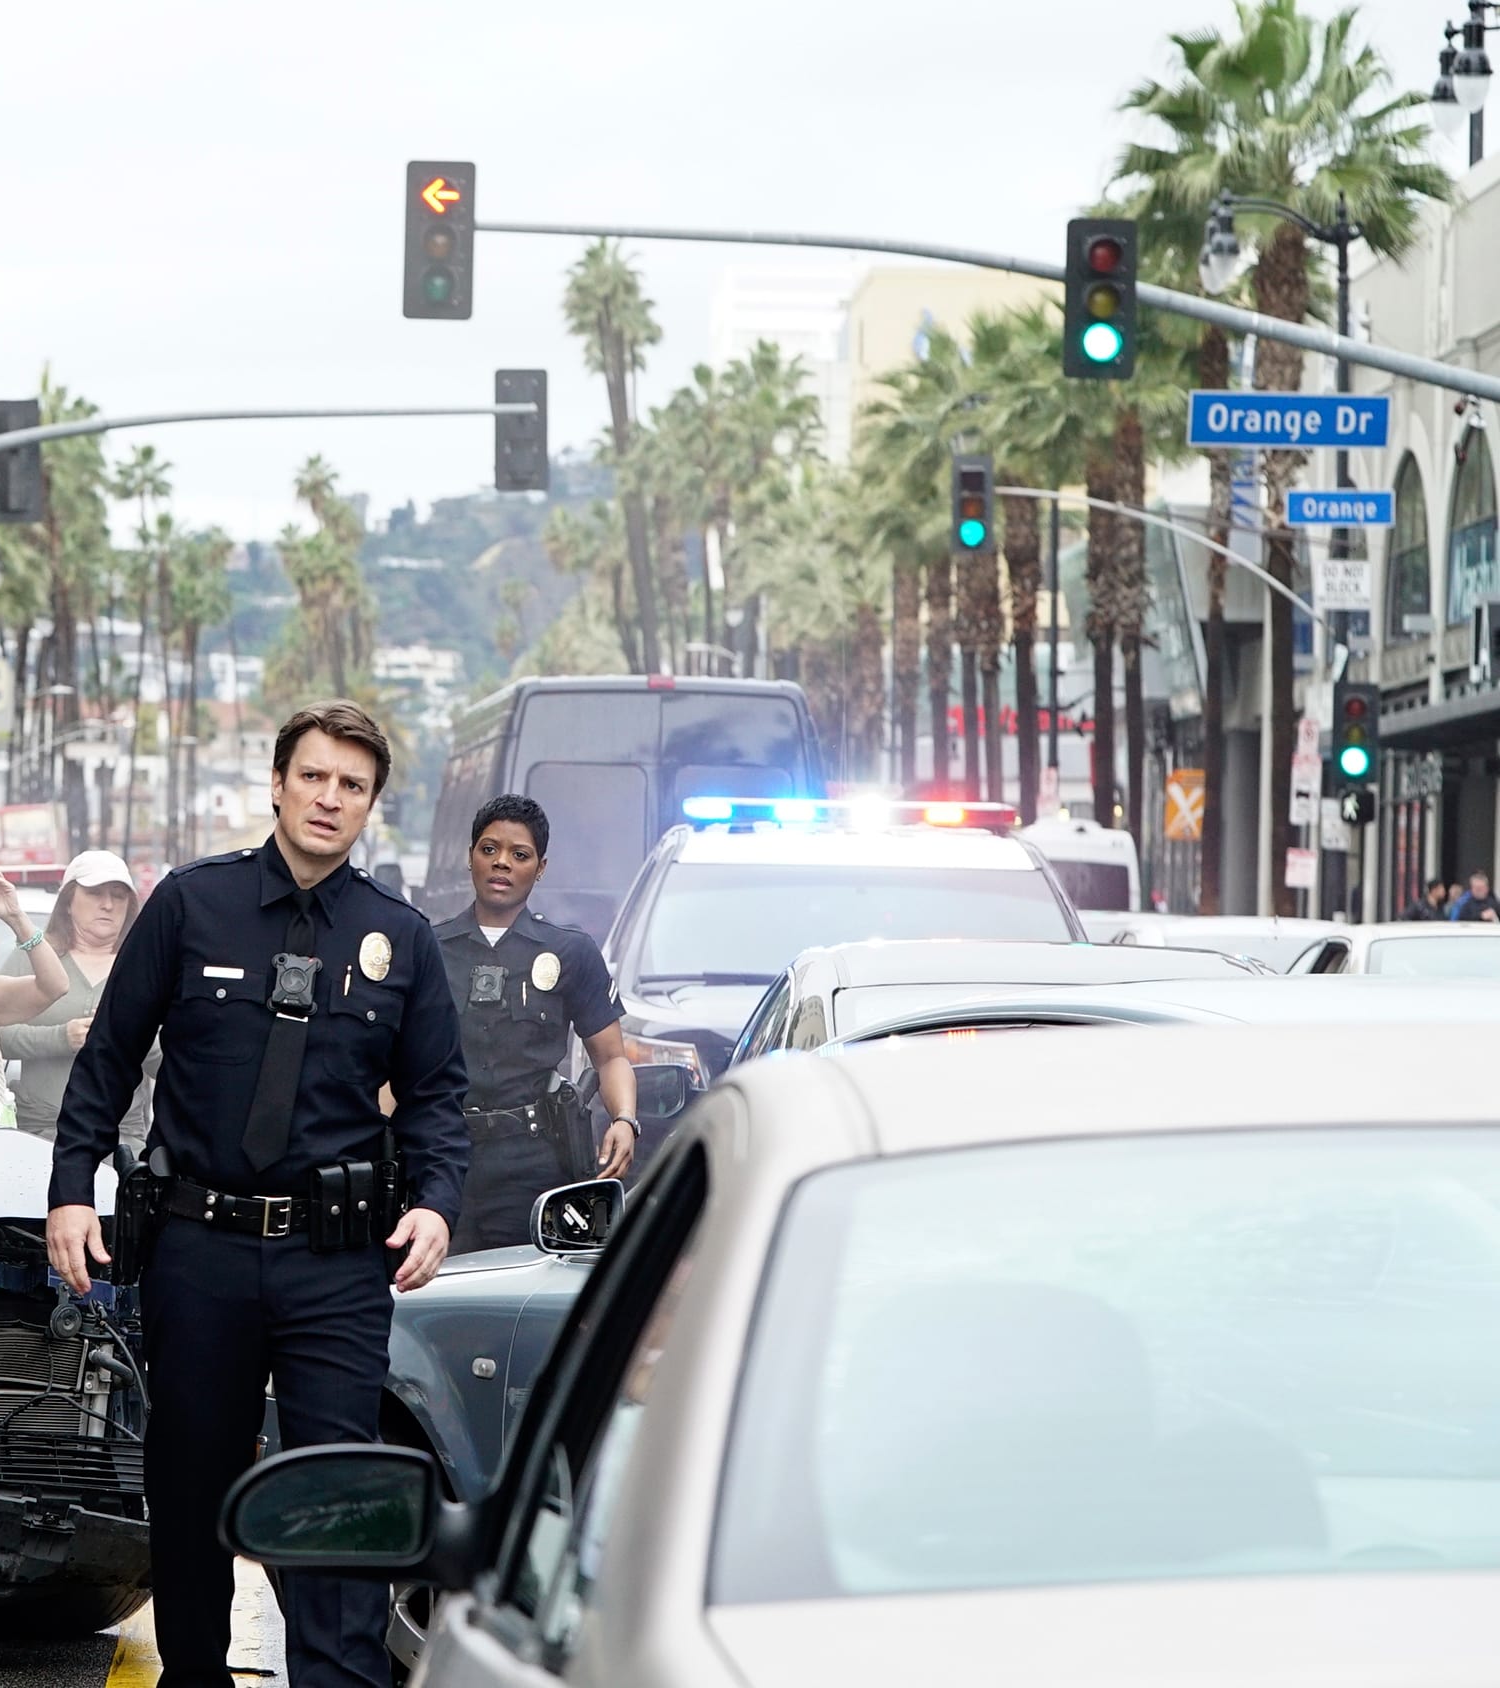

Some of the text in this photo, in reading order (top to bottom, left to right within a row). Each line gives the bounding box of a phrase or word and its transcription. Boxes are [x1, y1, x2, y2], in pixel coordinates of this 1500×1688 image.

[1207, 402, 1373, 441] Orange Dr
[1301, 497, 1377, 521] Orange
